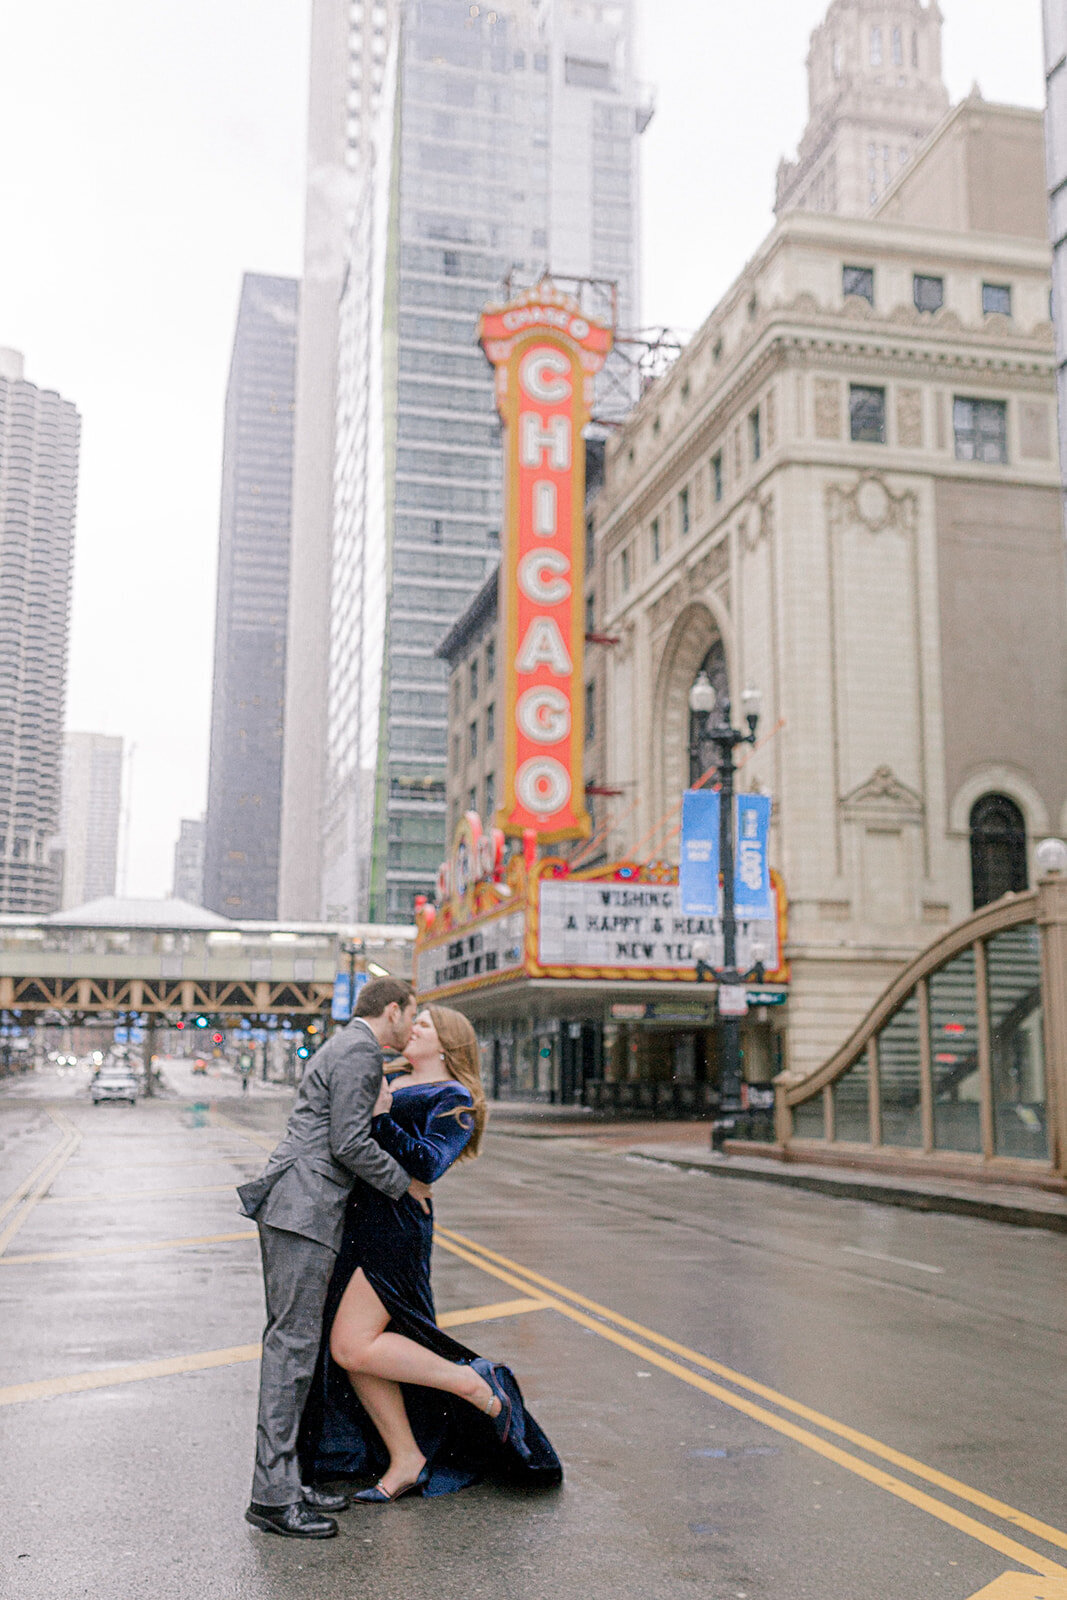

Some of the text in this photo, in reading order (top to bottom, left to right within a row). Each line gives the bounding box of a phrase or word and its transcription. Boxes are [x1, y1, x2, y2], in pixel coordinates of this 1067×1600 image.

[516, 346, 573, 817] CHICAGO
[601, 889, 673, 908] WISHING
[566, 915, 577, 931] A
[587, 915, 643, 934] HAPPY
[673, 918, 750, 936] HEALTY
[616, 942, 653, 960] NEW
